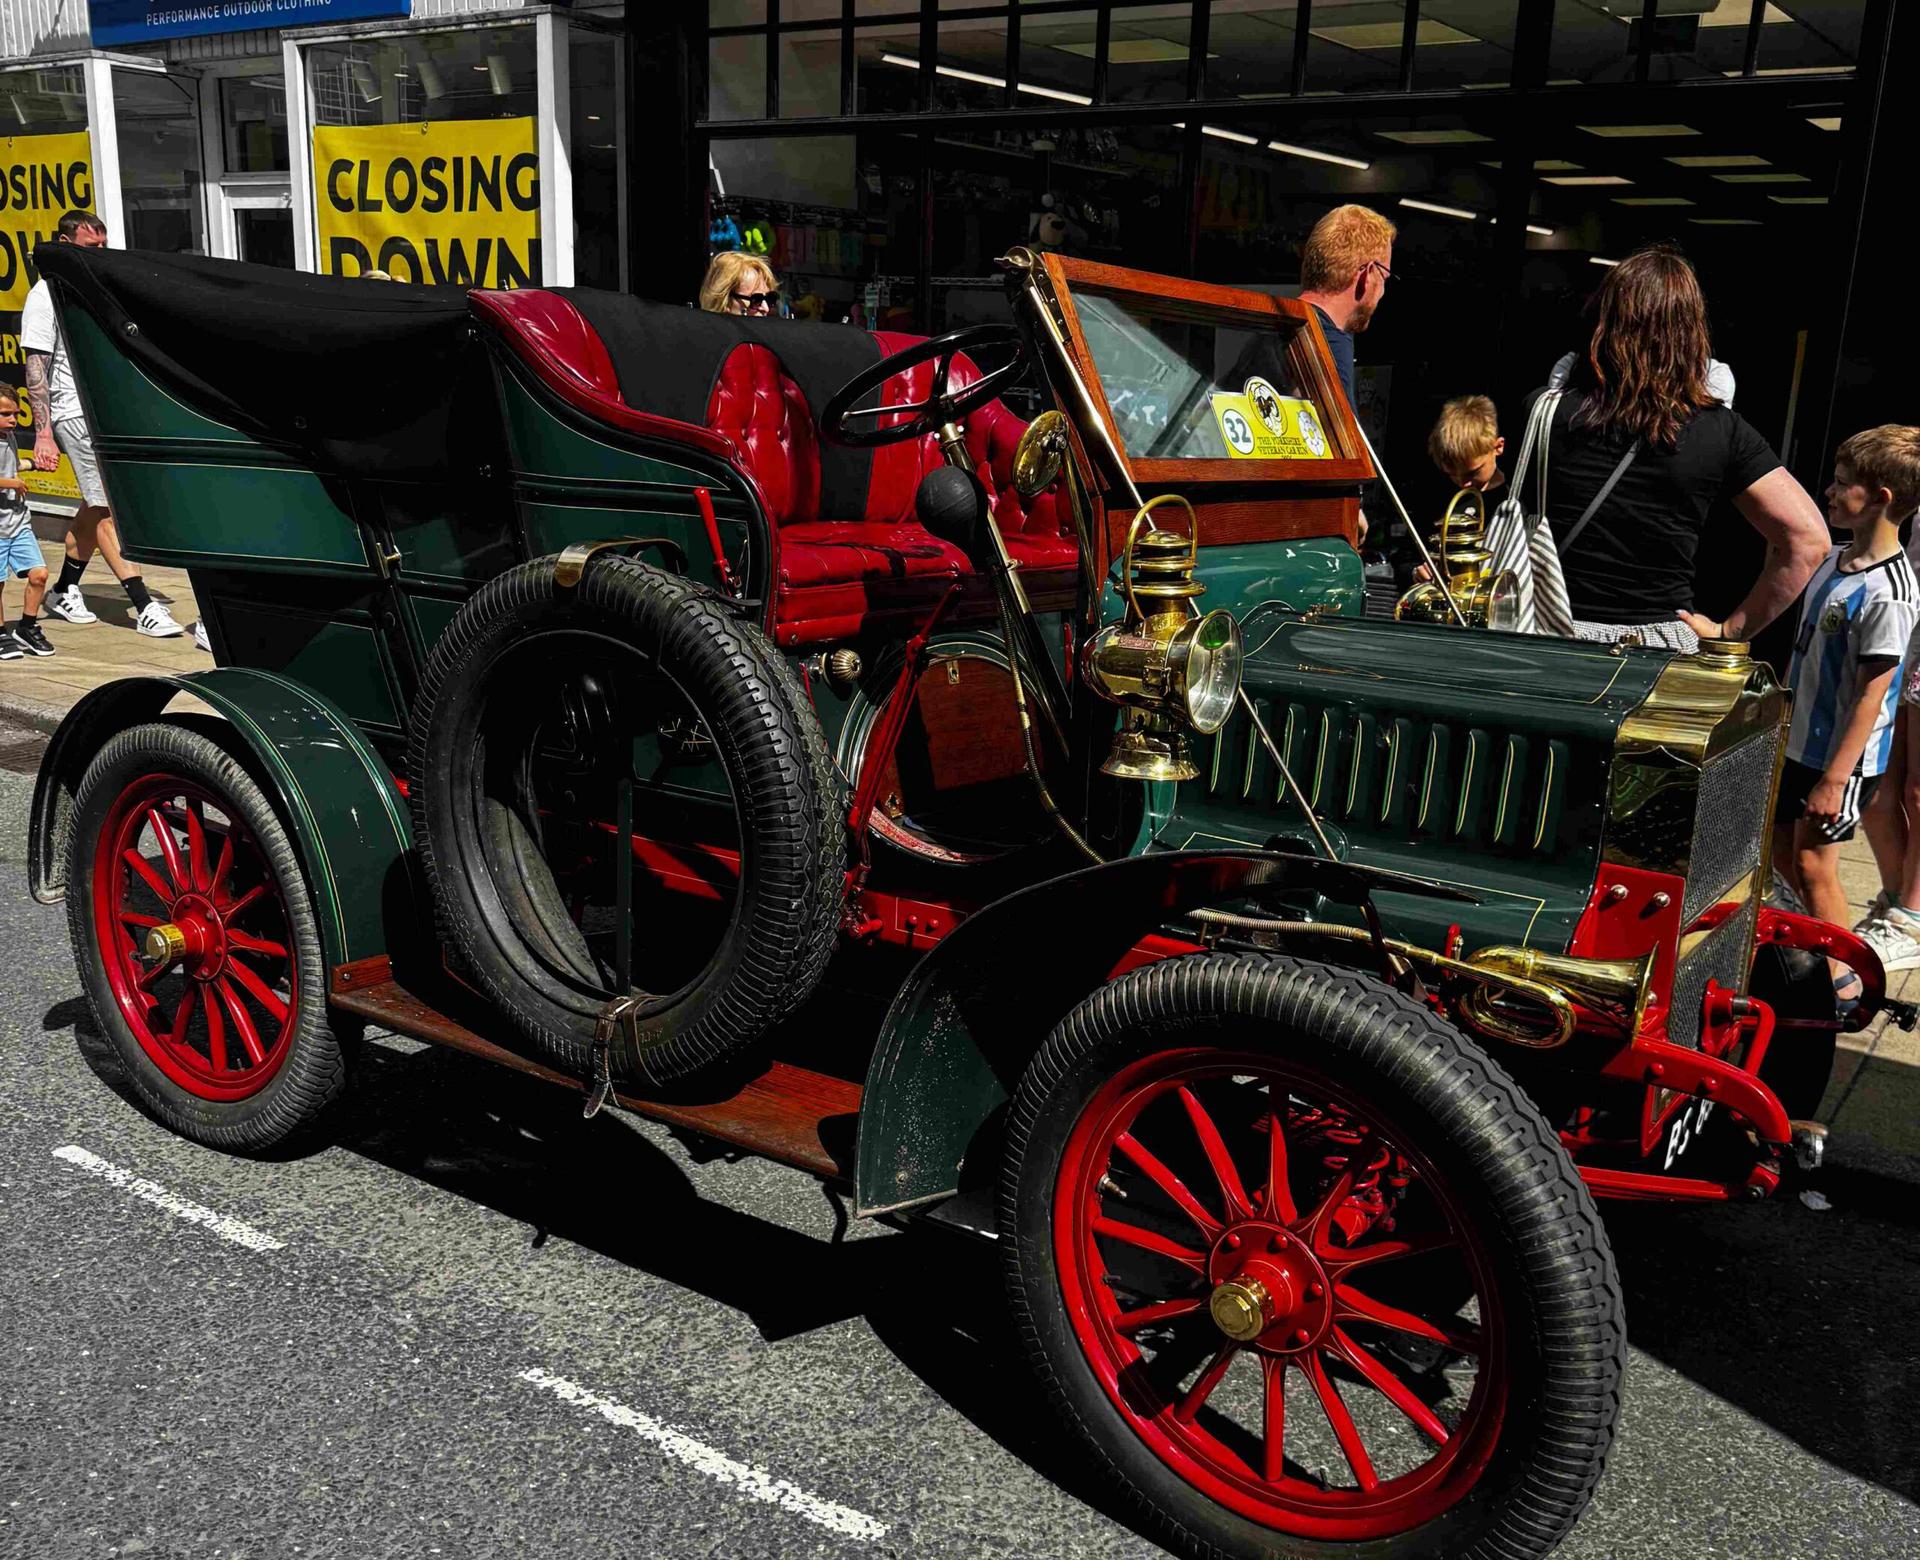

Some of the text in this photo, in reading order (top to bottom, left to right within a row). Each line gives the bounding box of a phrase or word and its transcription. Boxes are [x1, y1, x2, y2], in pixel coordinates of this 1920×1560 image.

[146, 5, 220, 26] PERFORMANCE
[223, 0, 272, 17] OUTDOOR
[327, 152, 541, 213] CLOSING
[329, 235, 543, 289] DOWN
[1225, 417, 1252, 444] 32
